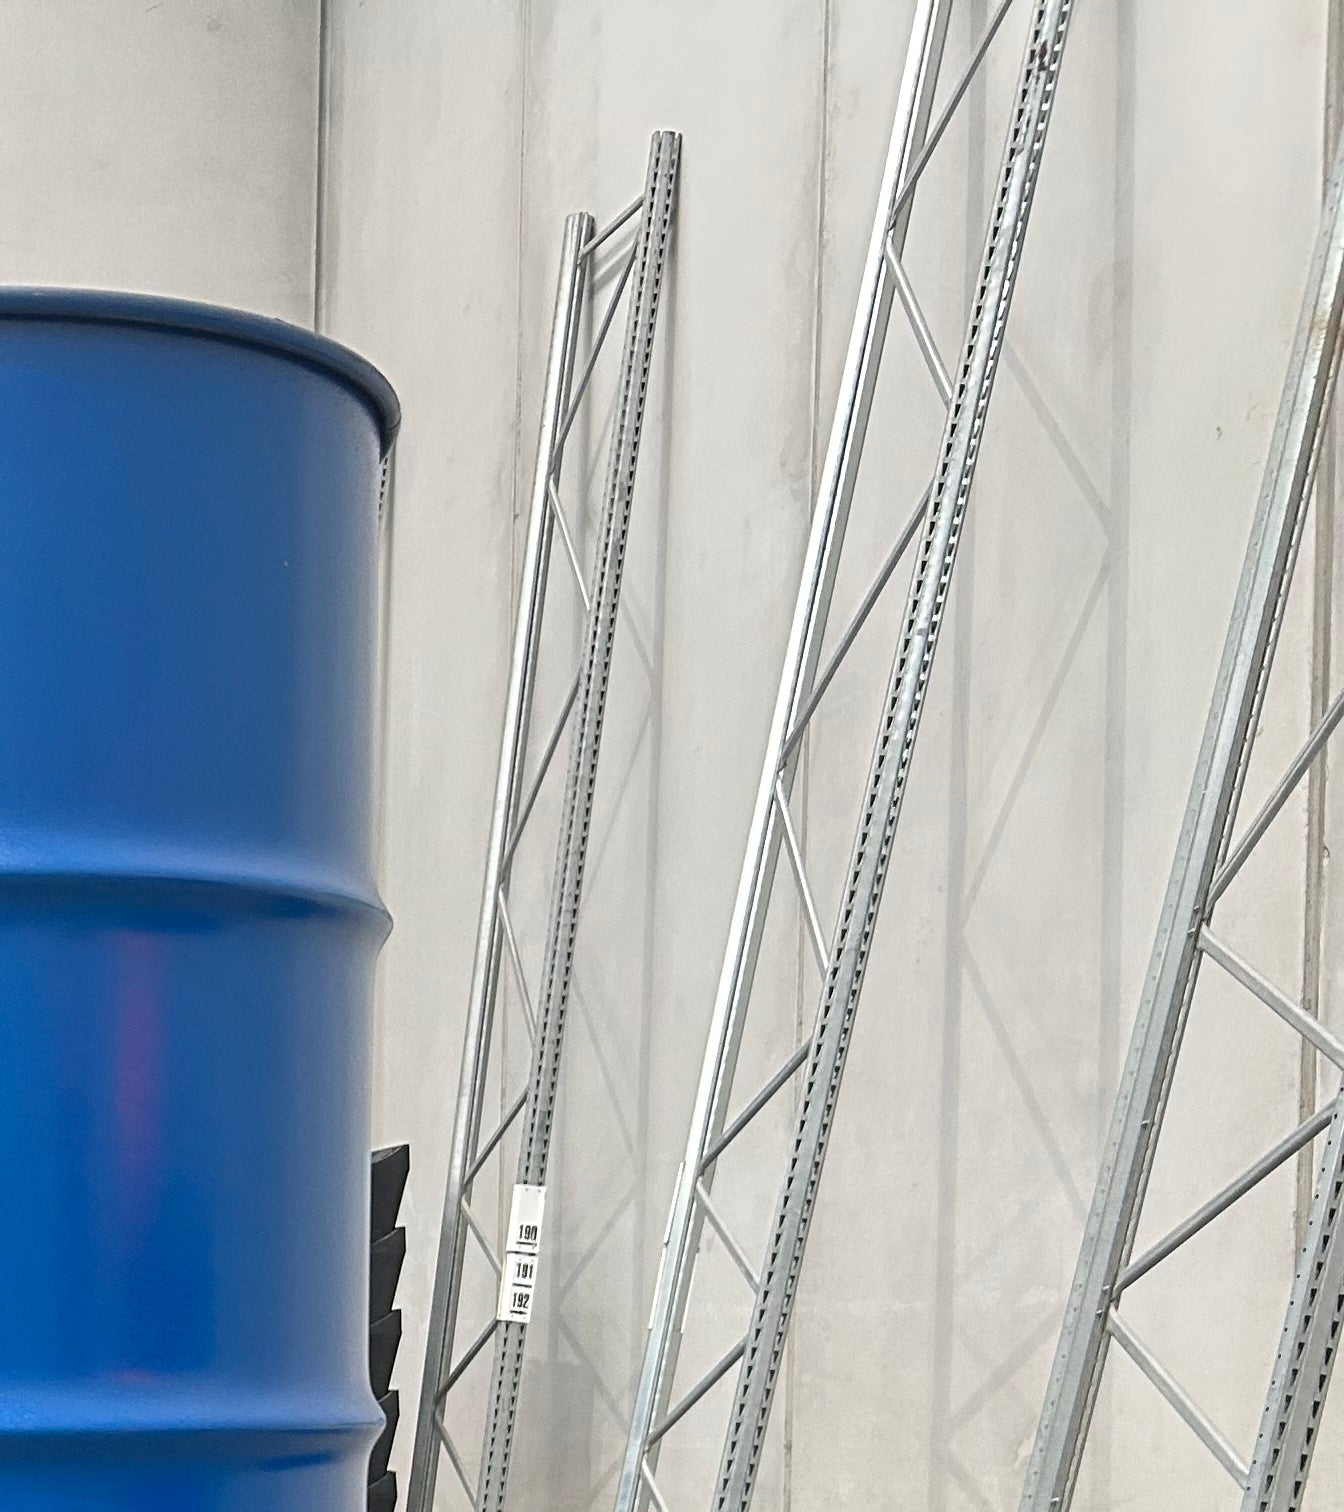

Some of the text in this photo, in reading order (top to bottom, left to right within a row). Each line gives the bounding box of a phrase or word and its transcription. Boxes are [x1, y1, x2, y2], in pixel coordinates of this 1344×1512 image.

[518, 1224, 538, 1241] 190
[516, 1262, 534, 1279] 191
[512, 1292, 530, 1309] 192
